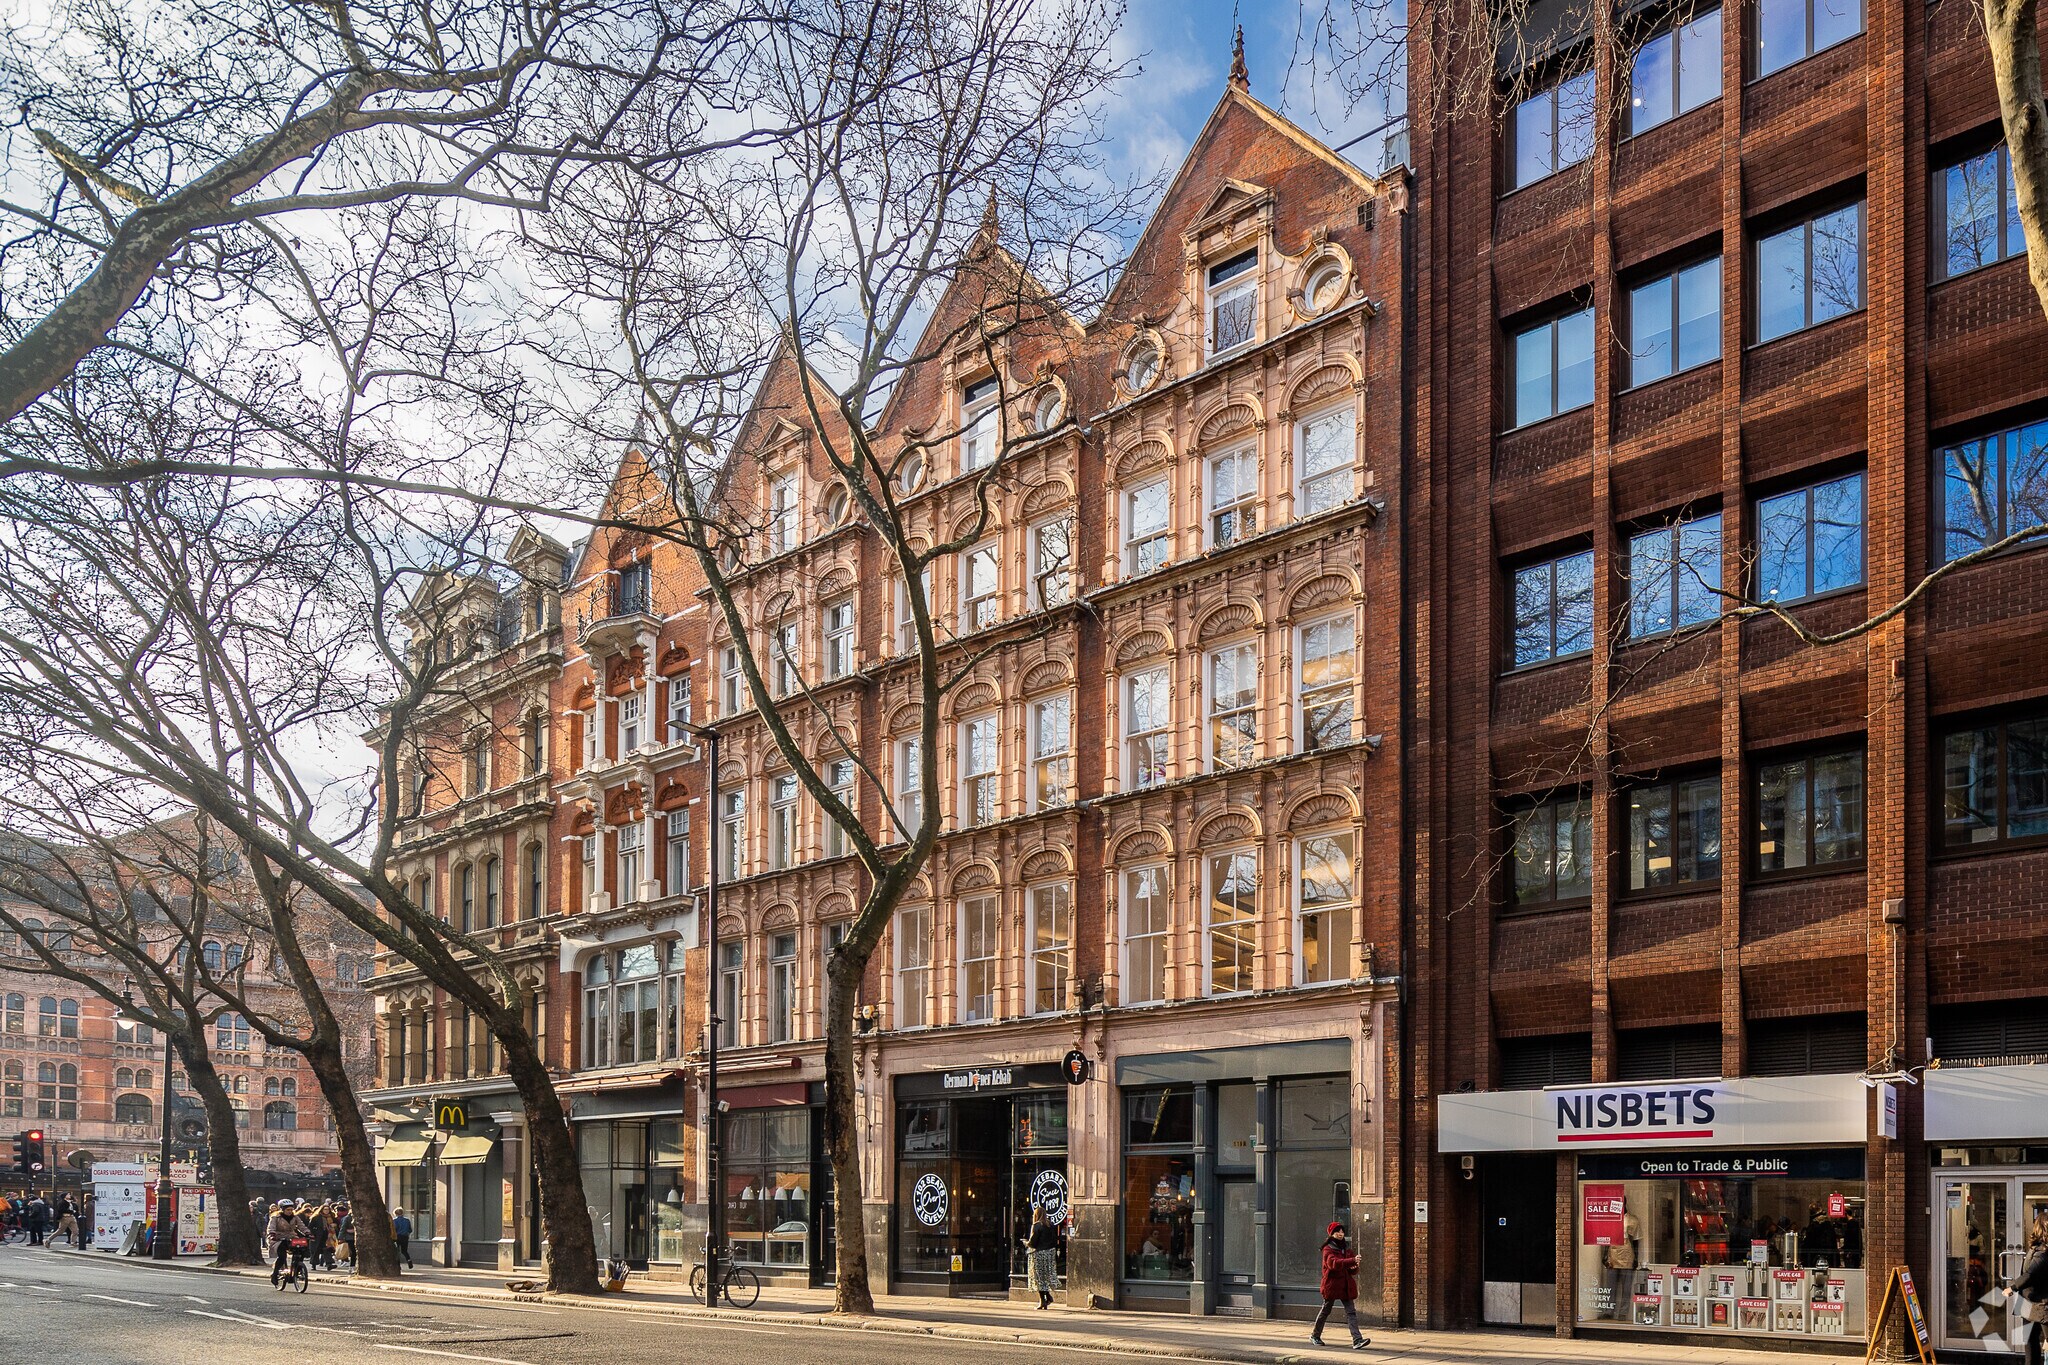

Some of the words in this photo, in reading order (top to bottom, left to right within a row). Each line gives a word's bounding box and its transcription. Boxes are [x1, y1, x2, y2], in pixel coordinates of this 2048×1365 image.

[943, 1073, 968, 1089] German
[991, 1069, 1012, 1086] Kebab
[1557, 1088, 1715, 1130] NISBETS
[1640, 1160, 1673, 1174] Open
[1676, 1160, 1690, 1172] to
[1692, 1159, 1729, 1172] Trade
[1732, 1159, 1743, 1171] &
[1746, 1158, 1788, 1171] Public
[916, 1179, 927, 1196] 102
[925, 1176, 946, 1197] SEATS
[1036, 1172, 1064, 1186] KEBABS
[922, 1191, 940, 1207] Over
[1040, 1187, 1060, 1204] Since
[1045, 1197, 1060, 1211] 1989
[1587, 1205, 1609, 1213] SALE
[920, 1206, 945, 1224] LEVELS
